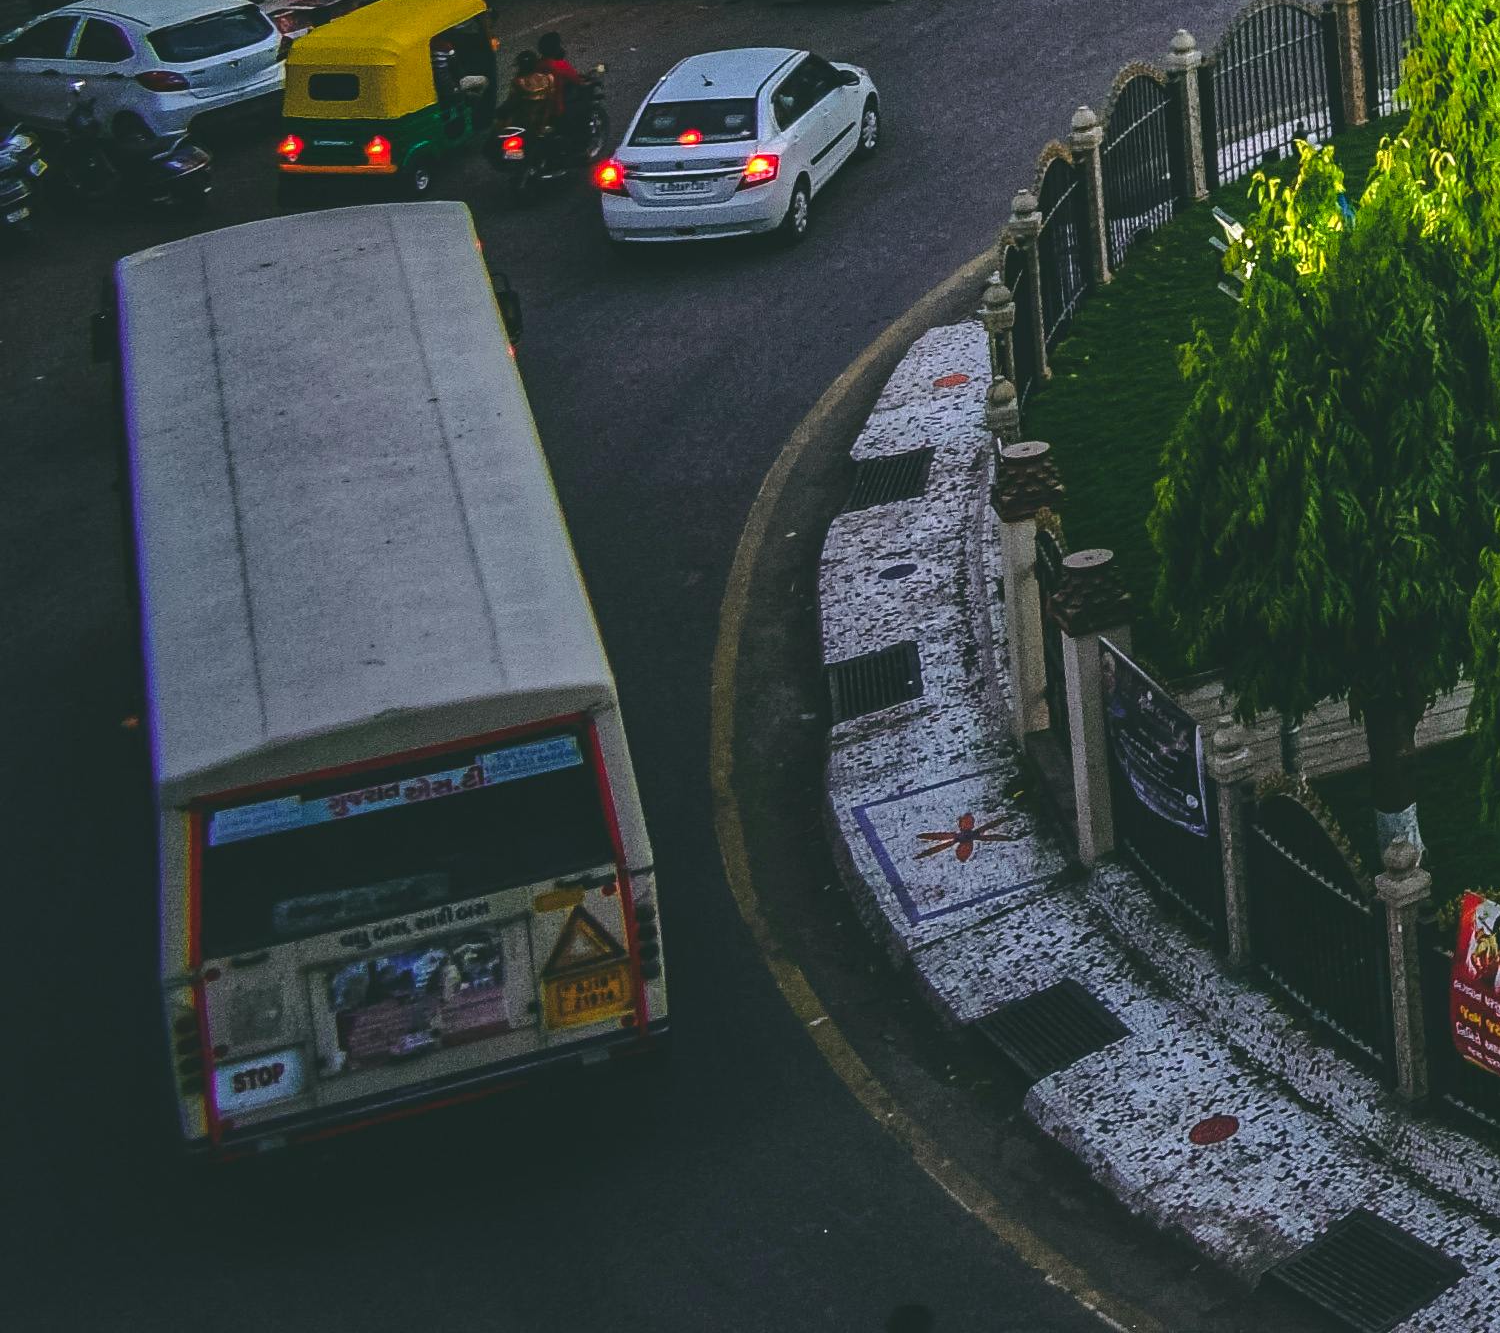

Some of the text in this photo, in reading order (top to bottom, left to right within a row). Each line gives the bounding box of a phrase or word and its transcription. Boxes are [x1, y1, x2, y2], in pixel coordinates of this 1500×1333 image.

[328, 780, 401, 819] ગુજરાત
[1459, 1004, 1483, 1028] જન્મ
[233, 1062, 285, 1094] STOP
